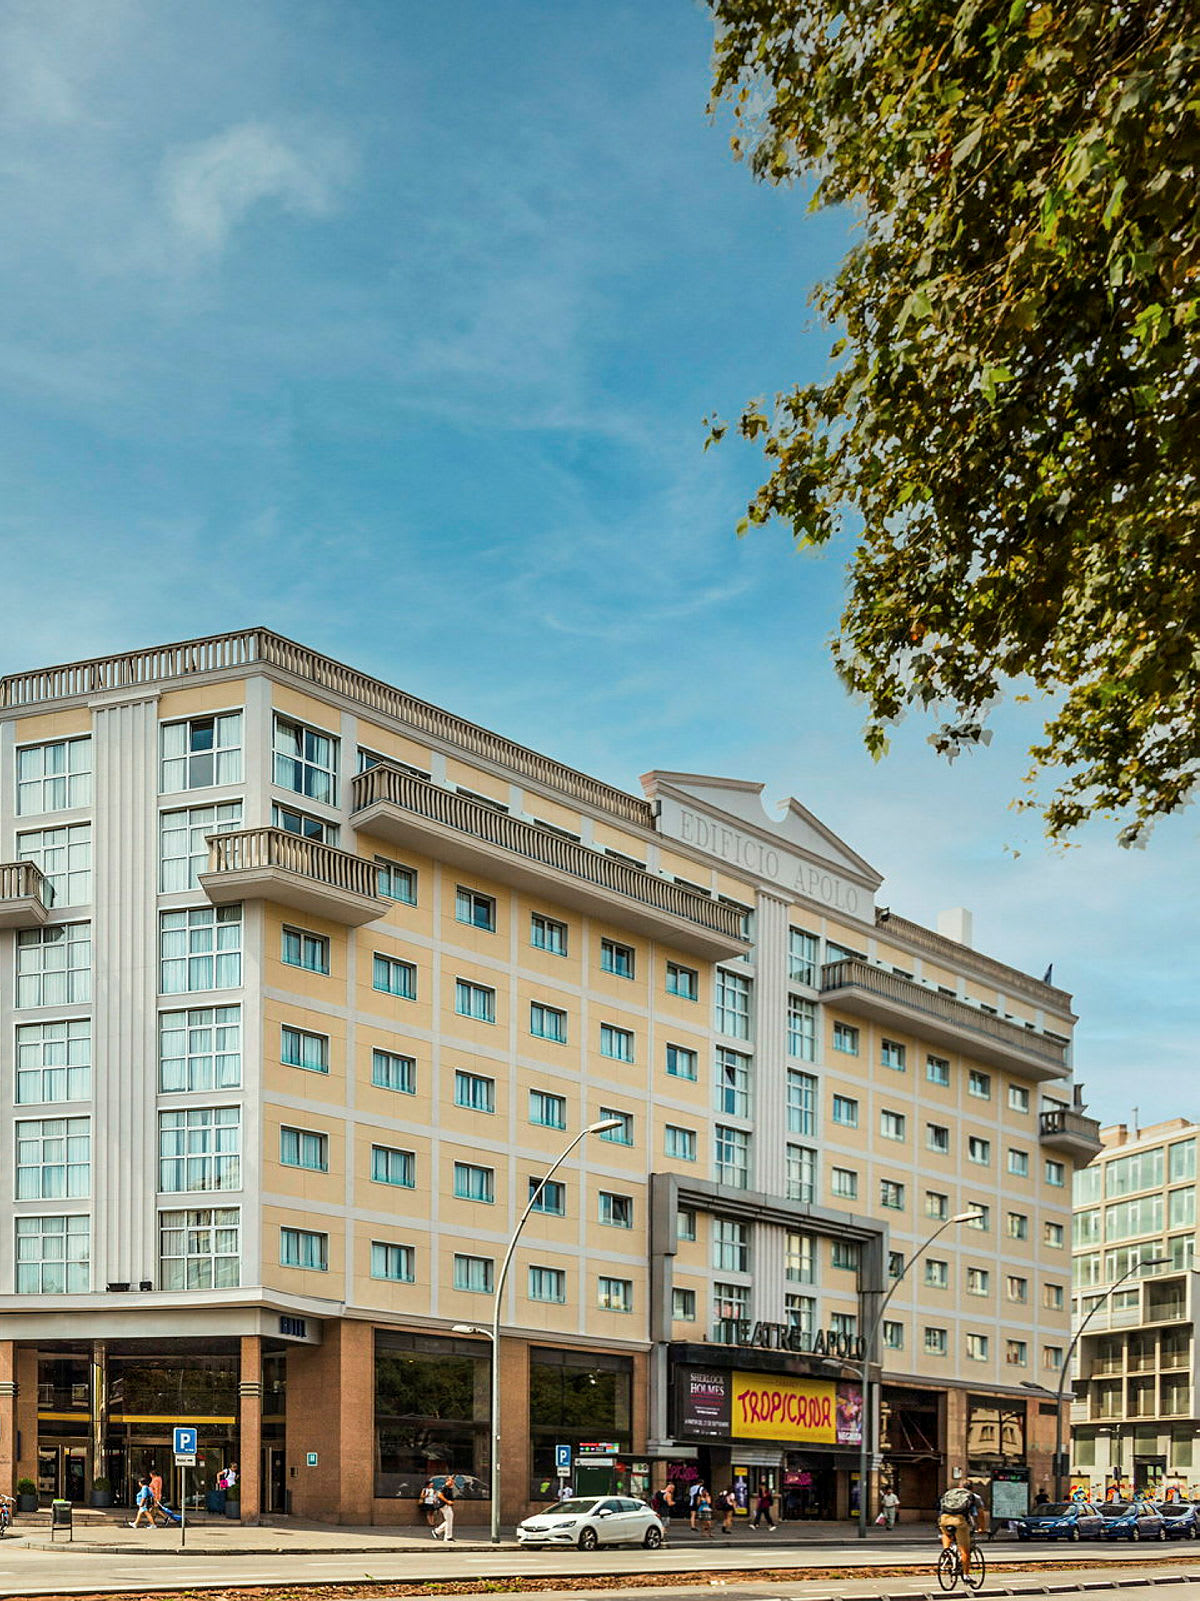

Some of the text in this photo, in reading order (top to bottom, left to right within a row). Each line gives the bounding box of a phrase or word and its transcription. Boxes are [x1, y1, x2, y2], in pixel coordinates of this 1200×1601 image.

[680, 809, 858, 914] EDIFICIO APOLO
[721, 1318, 868, 1361] TEATRE APOLO
[690, 1382, 725, 1397] HOLMES
[737, 1389, 832, 1429] TROPICANA
[180, 1432, 191, 1449] P
[560, 1449, 567, 1463] P
